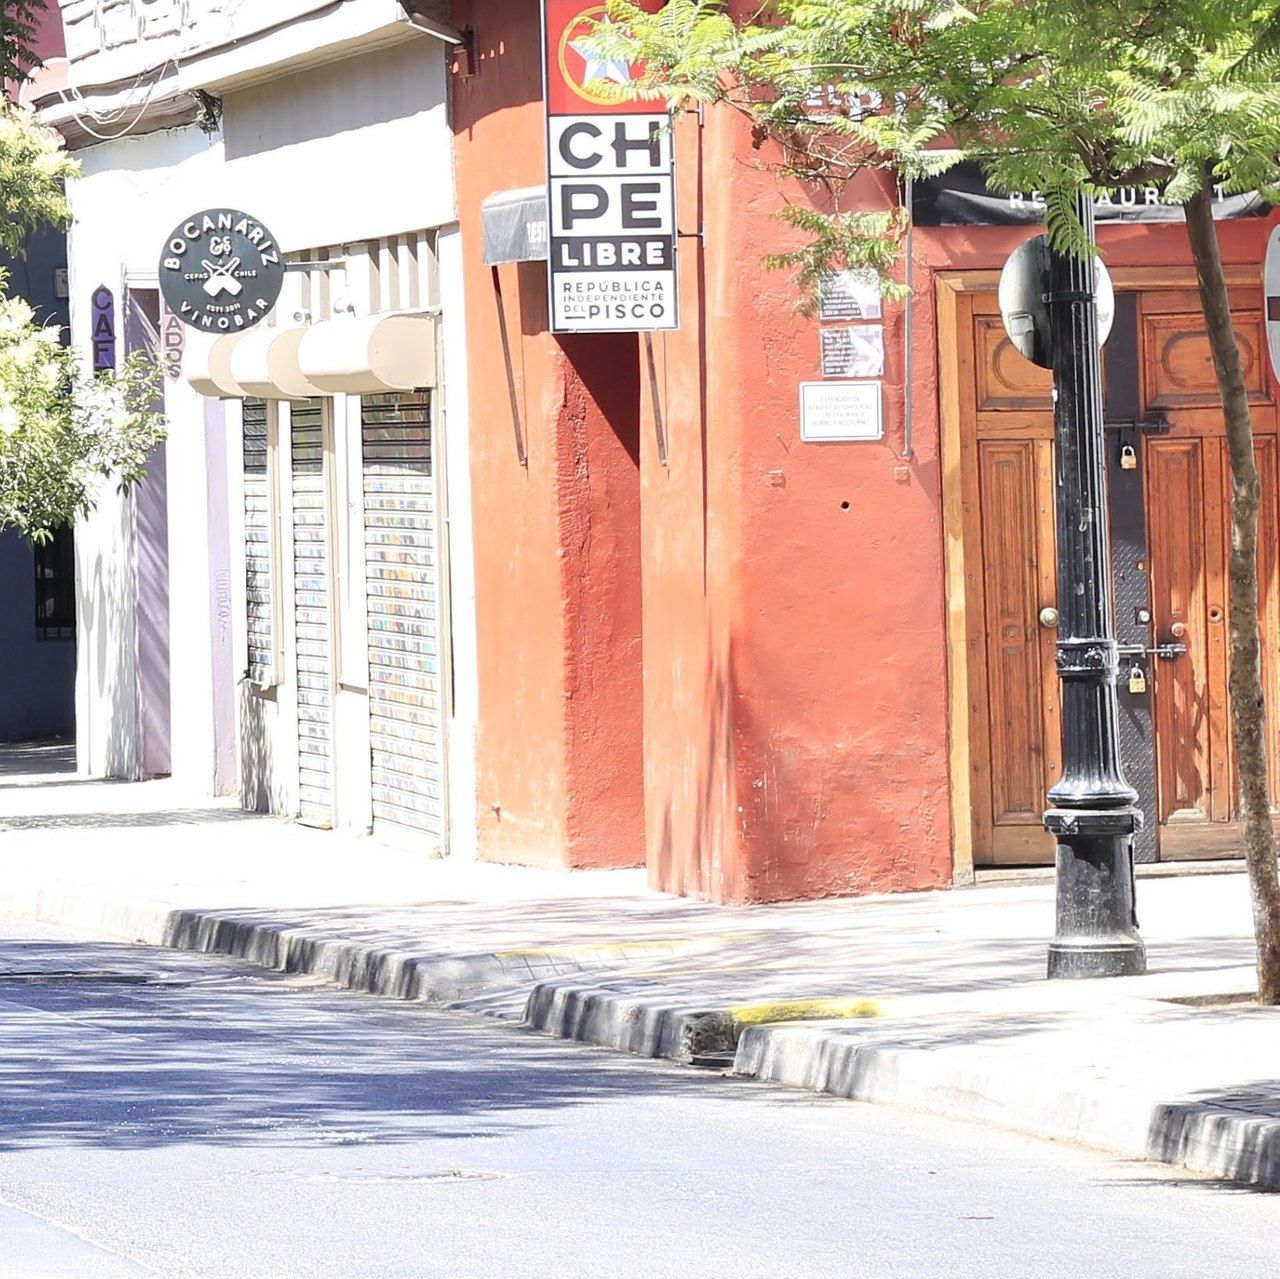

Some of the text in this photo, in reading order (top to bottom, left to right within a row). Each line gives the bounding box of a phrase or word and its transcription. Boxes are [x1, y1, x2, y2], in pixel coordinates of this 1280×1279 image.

[558, 121, 661, 169] CH
[560, 182, 662, 230] PE
[560, 241, 665, 267] LIBRE
[234, 269, 258, 278] CHILE
[563, 280, 664, 293] REPÚBLICA
[563, 293, 664, 302] INDEPENDIENTE
[180, 298, 268, 329] VINOBAR
[563, 303, 665, 319] DEL PISCO
